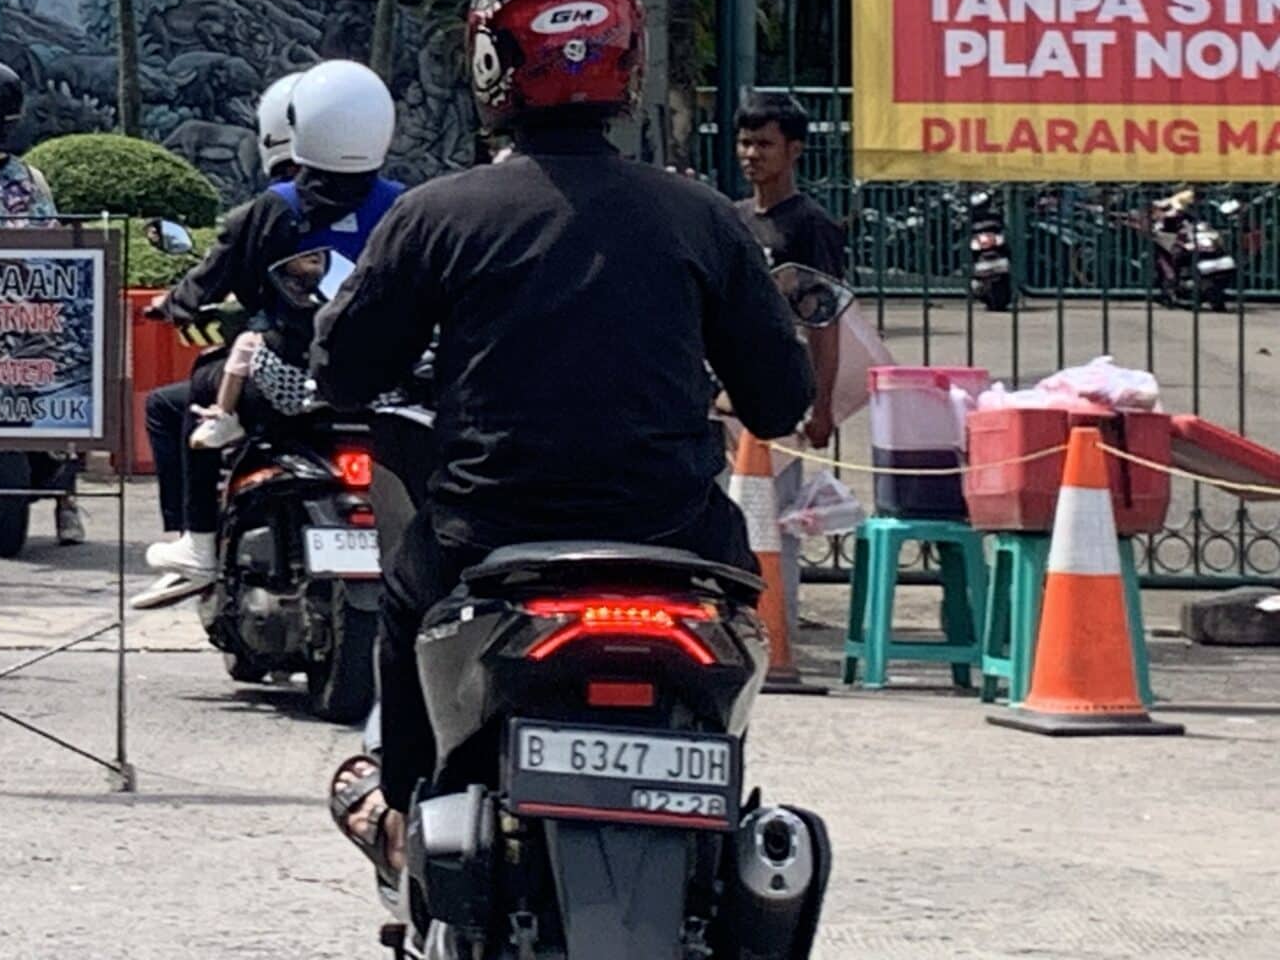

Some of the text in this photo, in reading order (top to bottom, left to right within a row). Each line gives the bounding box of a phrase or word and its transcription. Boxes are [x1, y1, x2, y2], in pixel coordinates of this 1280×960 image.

[943, 30, 1117, 78] PLAT
[921, 117, 1201, 155] DILARANG
[527, 735, 726, 781] B 6347 JDH
